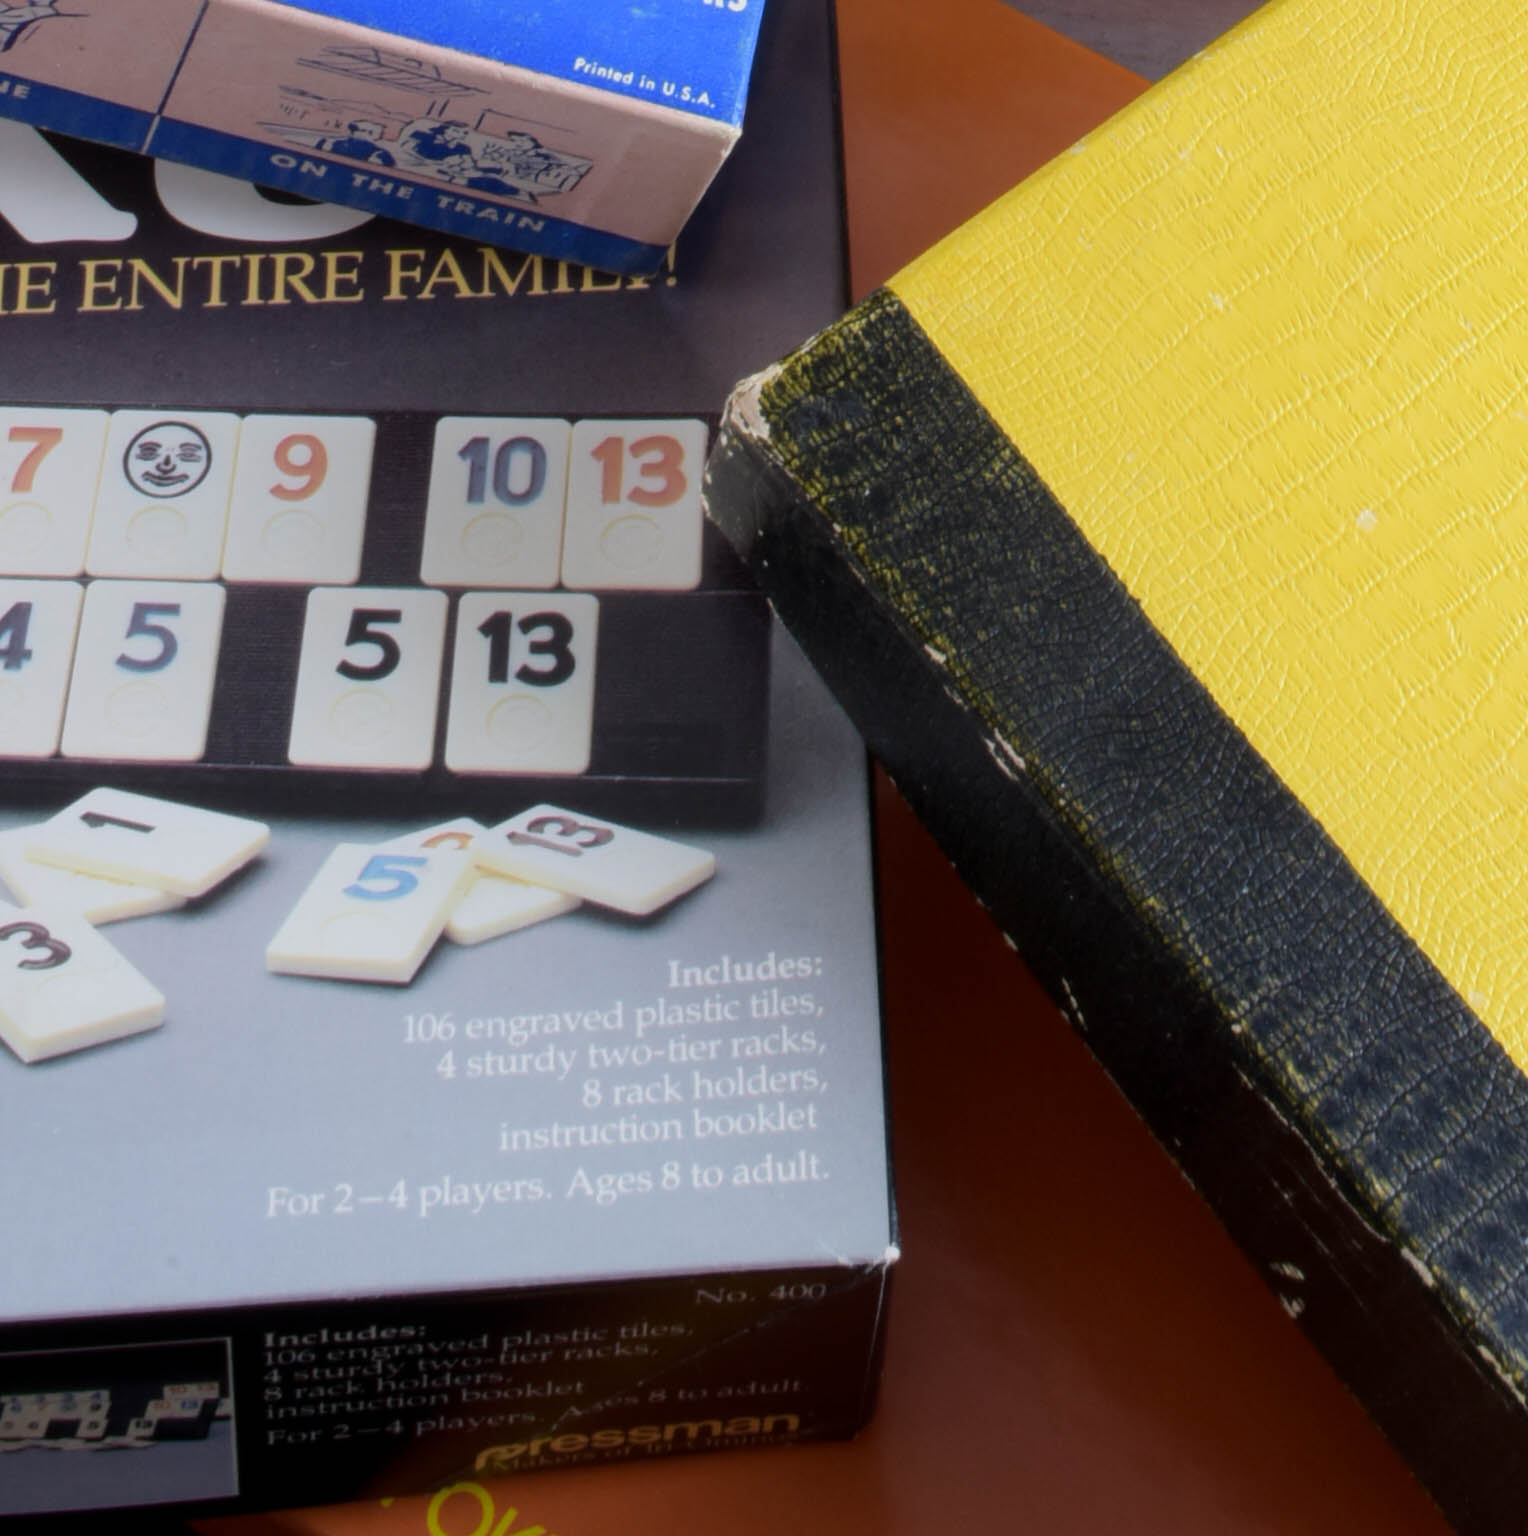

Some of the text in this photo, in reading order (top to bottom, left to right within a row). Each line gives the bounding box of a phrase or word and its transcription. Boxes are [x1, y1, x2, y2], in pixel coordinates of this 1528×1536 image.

[573, 56, 717, 109] Printed in U.S.A.
[269, 152, 548, 233] ON THE TRAIN
[77, 247, 365, 313] ENTIRE
[382, 241, 678, 302] FAMIL!
[4, 427, 689, 507] 7 9 10 13
[114, 601, 183, 674] 5
[335, 608, 403, 682] 5
[476, 611, 577, 687] 13
[342, 854, 429, 902] 5
[668, 952, 824, 988] Includes:
[402, 989, 825, 1047] 106 engraved plastic tiles,
[436, 1026, 827, 1082] 4 sturdy two-tier racks,
[581, 1065, 829, 1109] 8 rack holders,
[499, 1102, 818, 1152] instruction booklet
[265, 1186, 321, 1218] For
[418, 1173, 553, 1216] players.
[565, 1166, 653, 1205] Ages
[661, 1159, 682, 1189] 8
[690, 1162, 725, 1189] to
[731, 1150, 831, 1186] adult.
[695, 1282, 828, 1305] No. 400
[263, 1324, 428, 1348] Includes:
[263, 1350, 317, 1367] 106
[326, 1333, 490, 1362] engraved
[502, 1326, 609, 1354] plastic
[263, 1369, 283, 1386] 4
[292, 1359, 407, 1384] sturdy
[417, 1348, 553, 1372] two-tier
[262, 1385, 284, 1401] 8
[294, 1382, 367, 1400] rack
[265, 1380, 585, 1421] instruction booklet
[266, 1426, 325, 1446] For
[415, 1412, 546, 1437] players.
